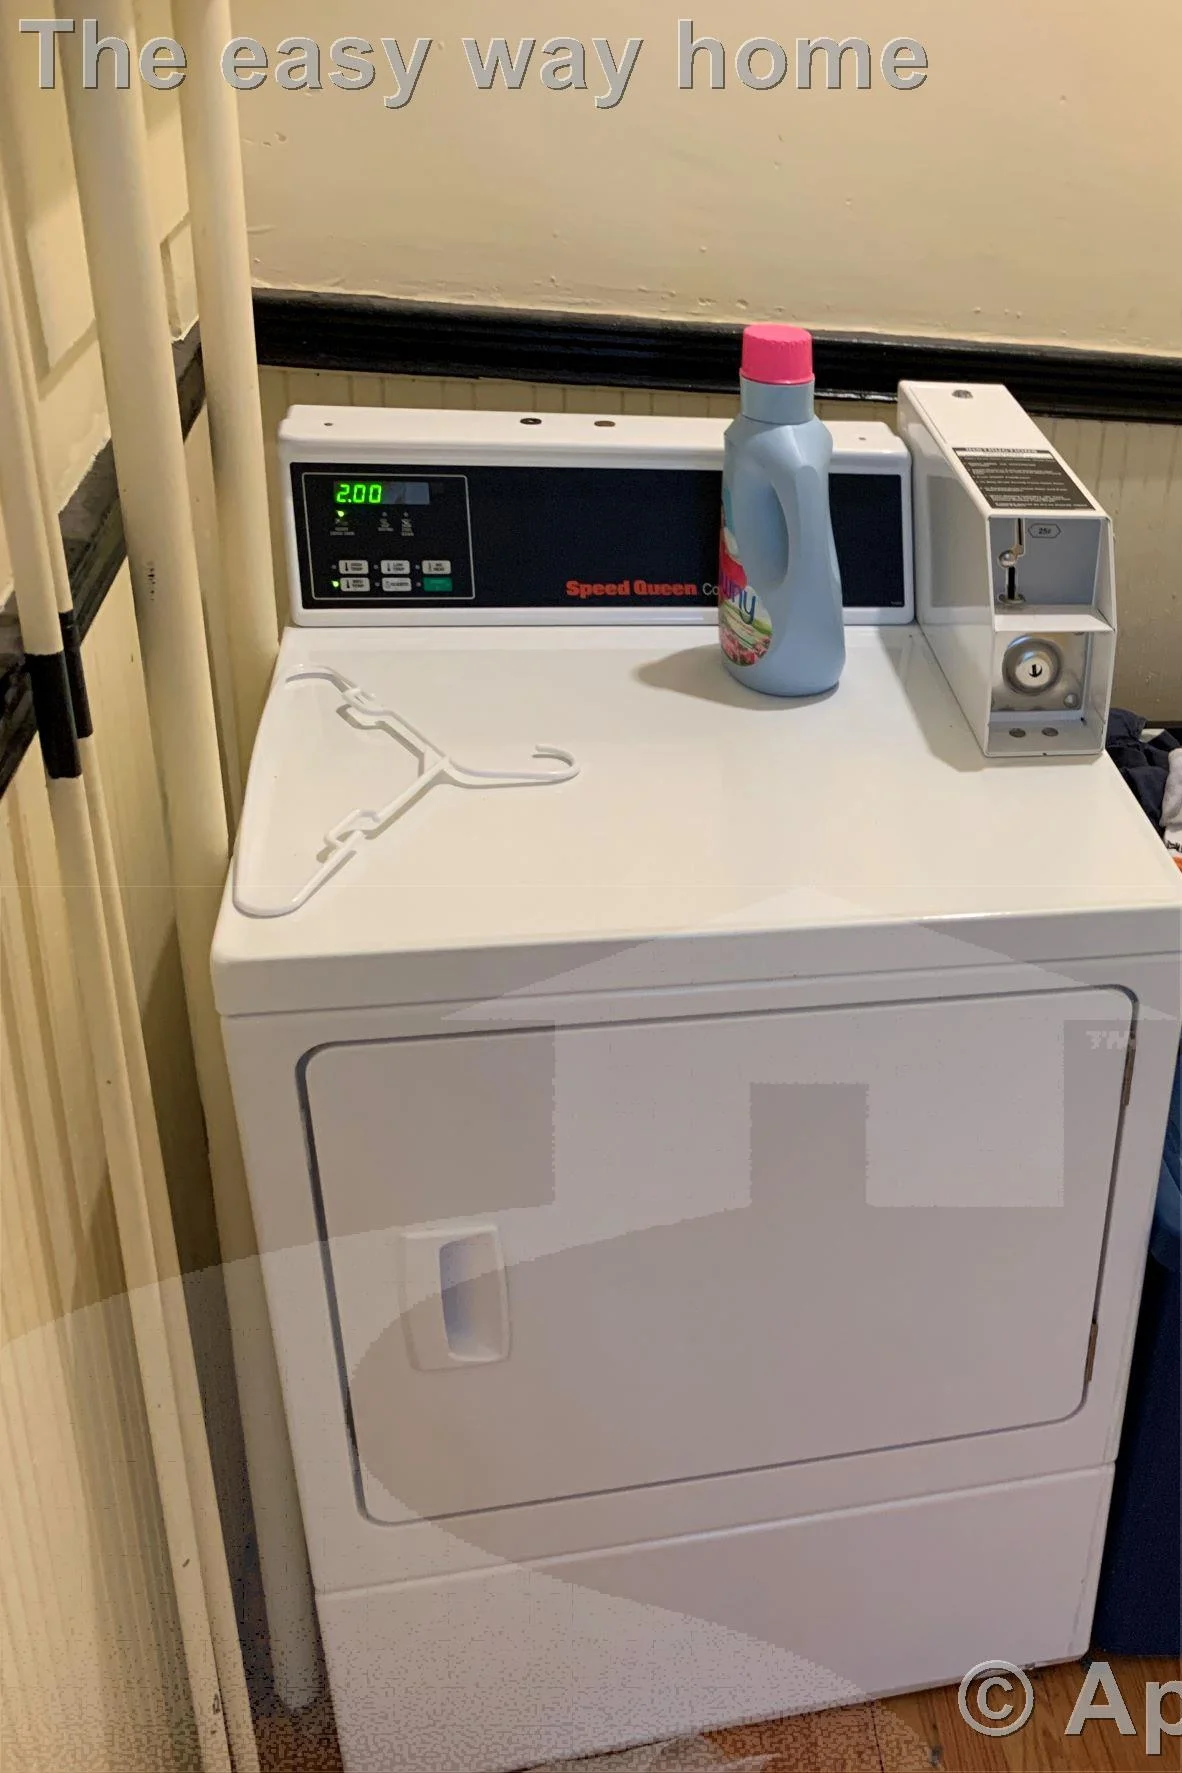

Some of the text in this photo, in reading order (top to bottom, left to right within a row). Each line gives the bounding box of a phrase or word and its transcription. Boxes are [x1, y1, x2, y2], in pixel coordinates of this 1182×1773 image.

[336, 484, 382, 503] 2.00
[566, 579, 630, 599] Speed
[634, 579, 698, 596] Queen
